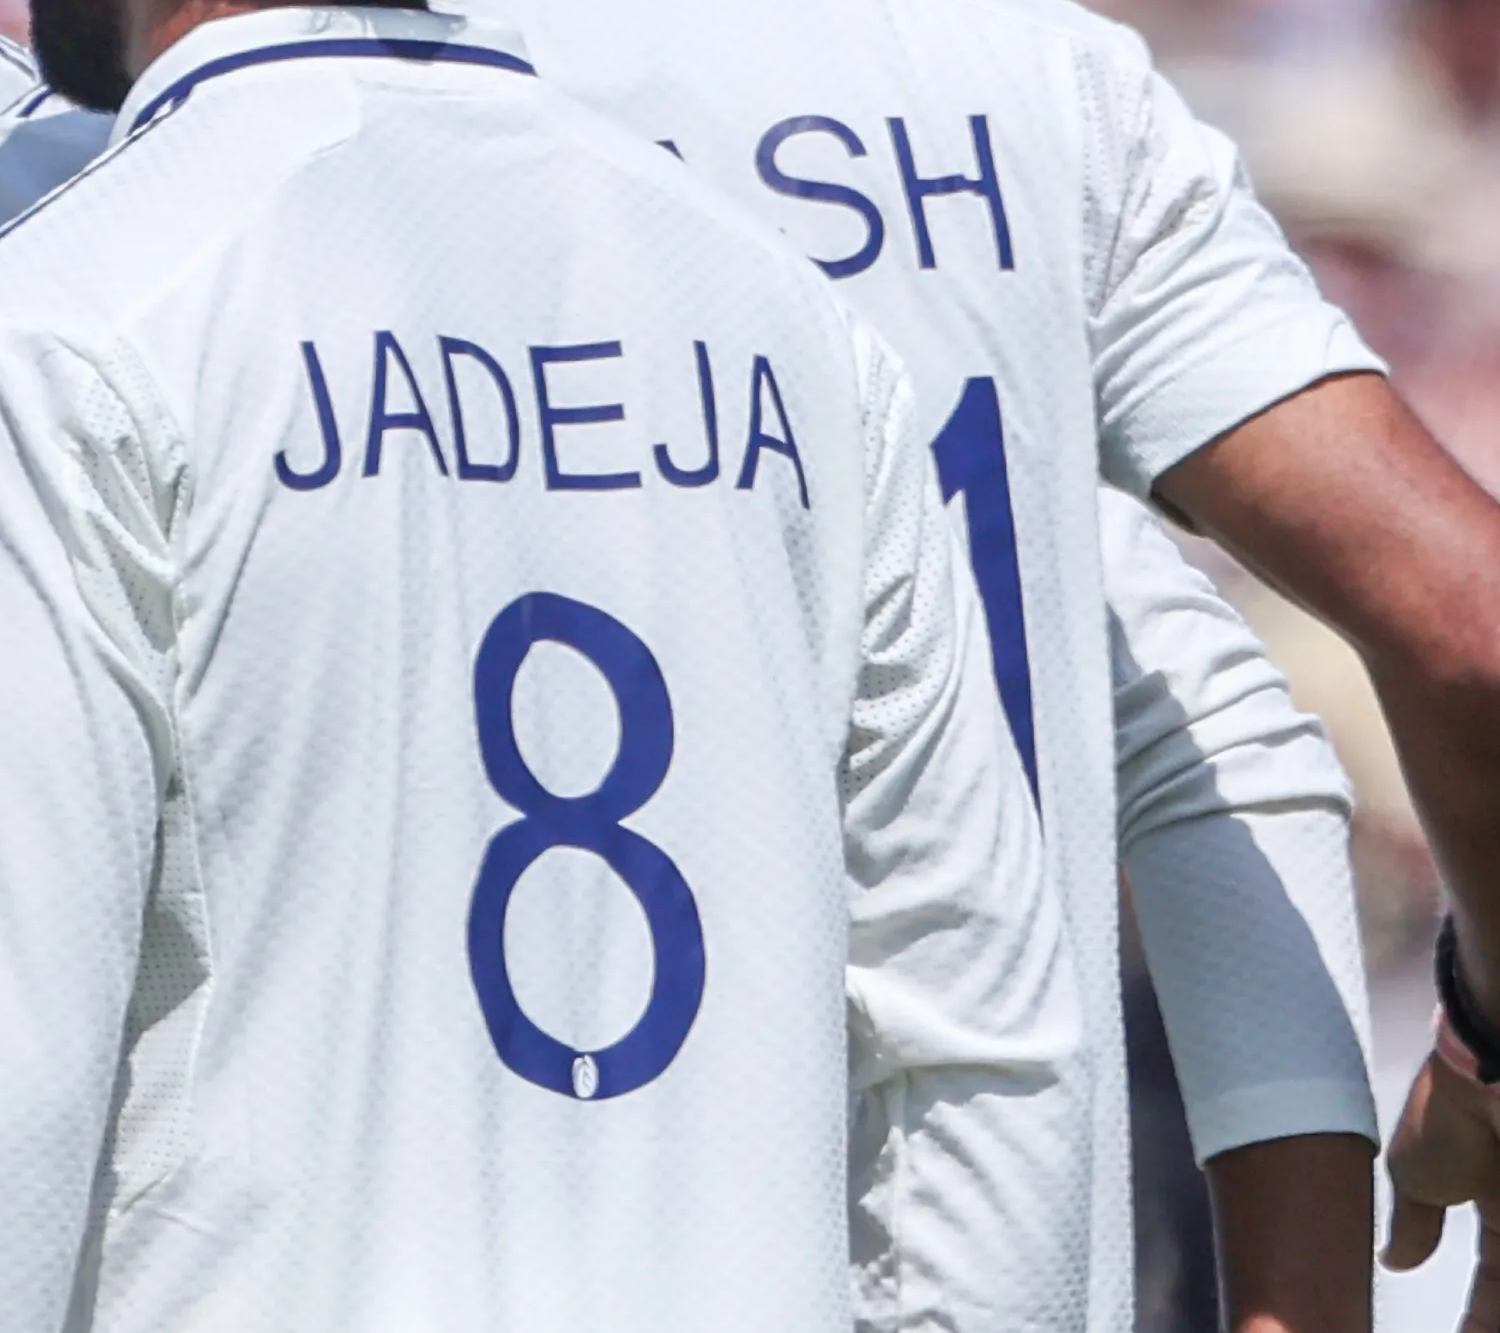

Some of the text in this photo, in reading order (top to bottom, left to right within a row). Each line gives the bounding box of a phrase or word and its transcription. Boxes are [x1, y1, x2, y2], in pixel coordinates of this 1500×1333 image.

[654, 113, 1014, 280] SH
[273, 329, 810, 510] JADEJA
[466, 590, 707, 1102] 8
